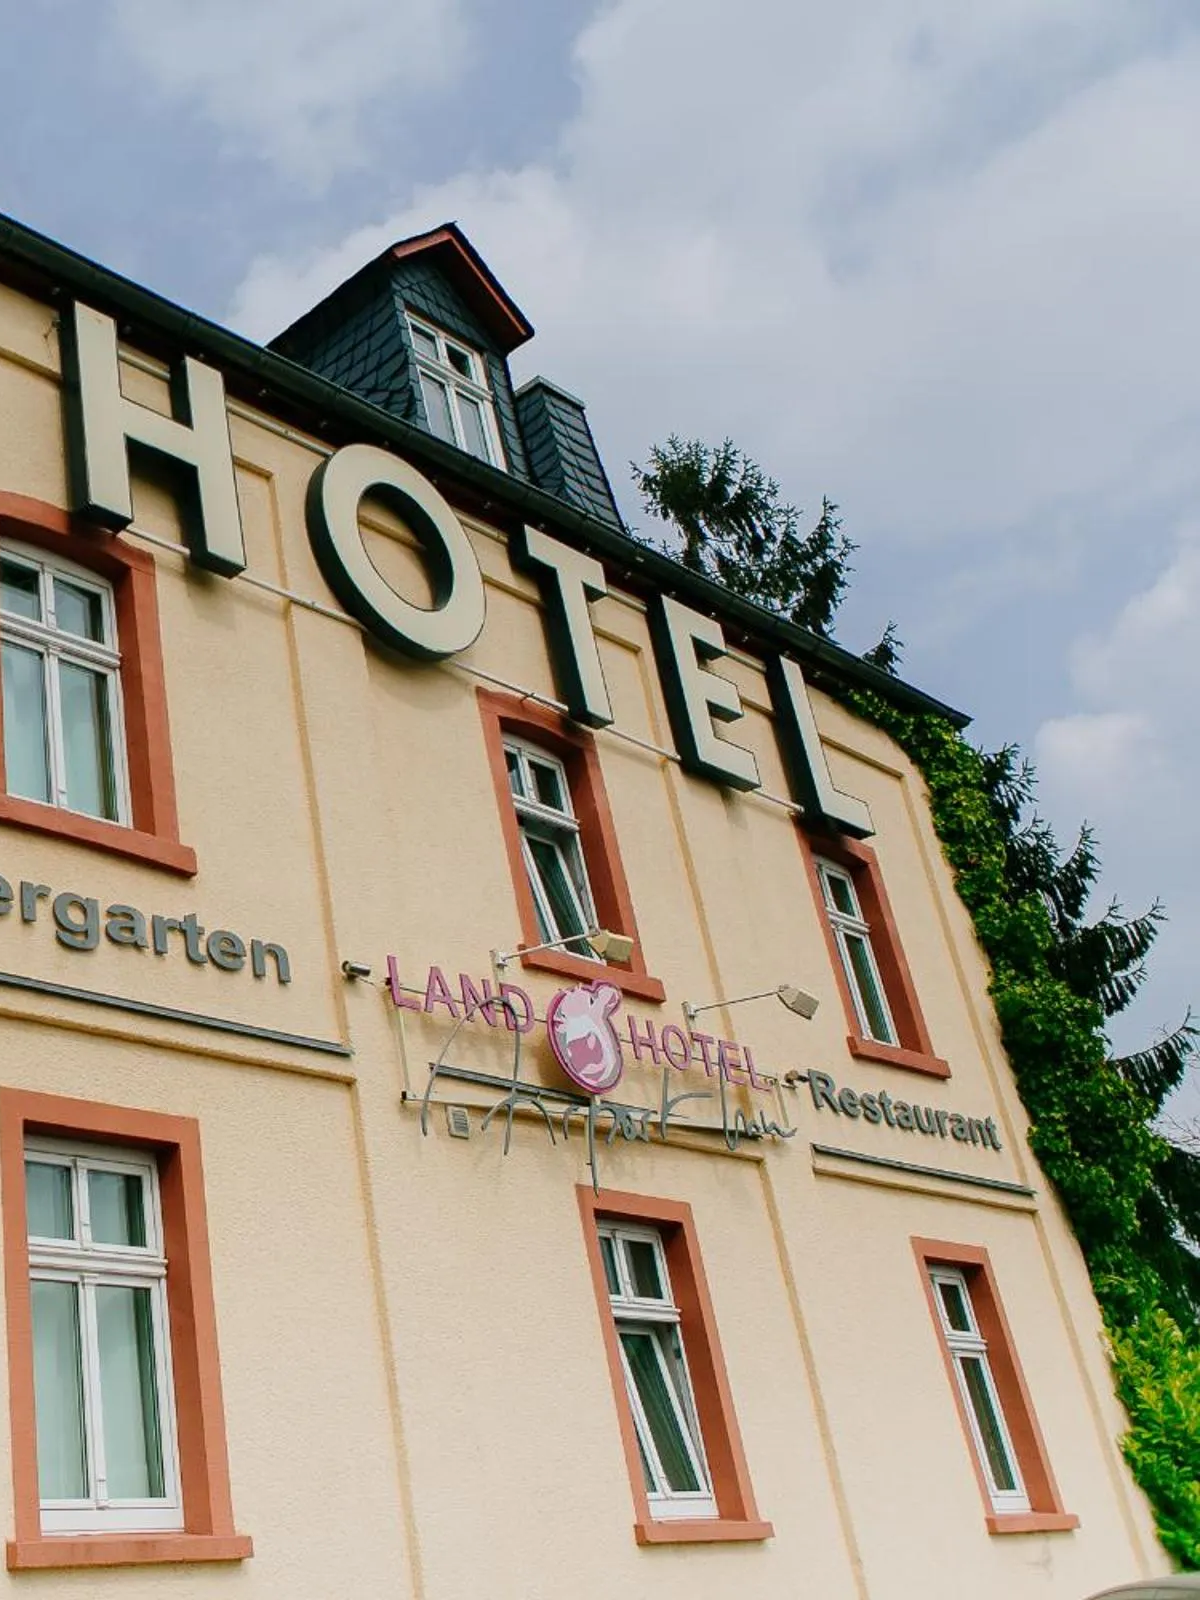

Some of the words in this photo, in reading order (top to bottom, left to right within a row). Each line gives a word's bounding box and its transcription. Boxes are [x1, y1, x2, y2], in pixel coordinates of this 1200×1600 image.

[62, 299, 875, 839] HOTEL
[386, 954, 536, 1034] LAND
[627, 1014, 778, 1092] HOTEL
[807, 1068, 1002, 1150] Restaurant
